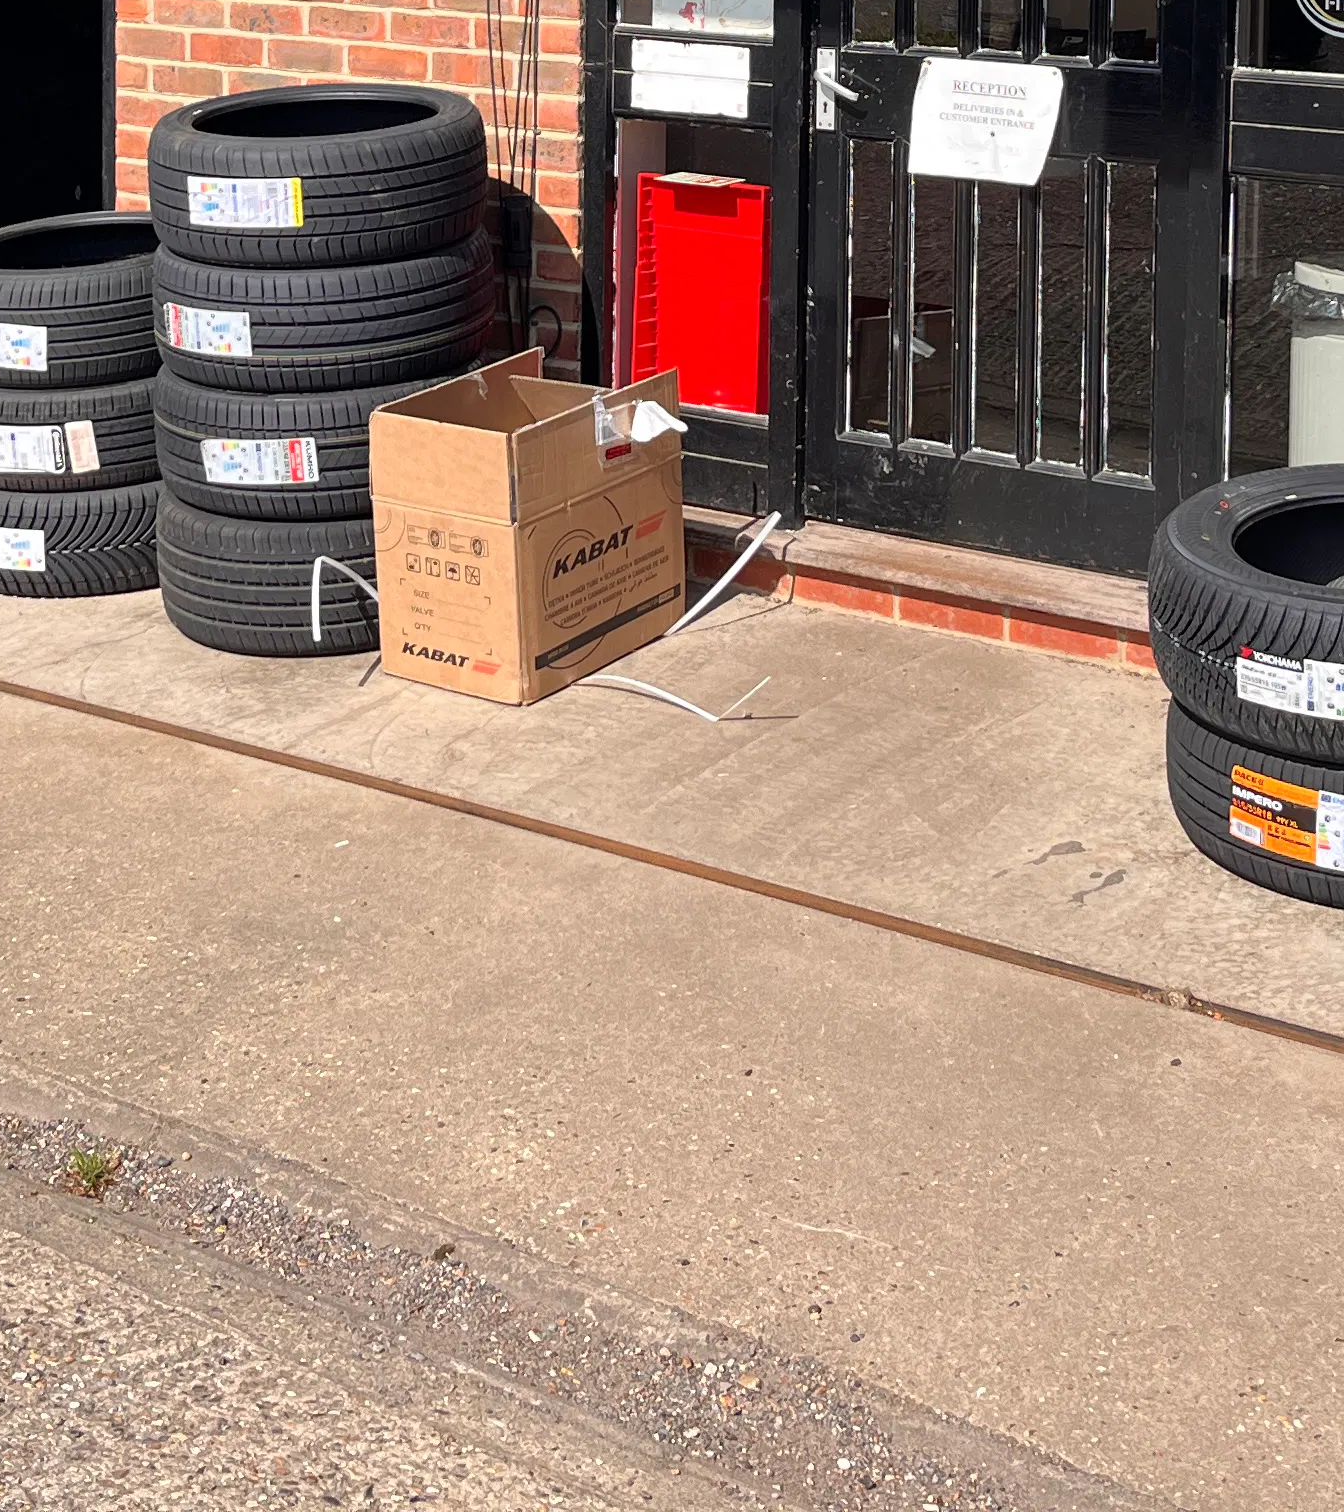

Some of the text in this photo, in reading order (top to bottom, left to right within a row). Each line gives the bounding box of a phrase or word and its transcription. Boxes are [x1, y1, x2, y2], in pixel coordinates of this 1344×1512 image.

[952, 80, 1027, 97] RECEPTION
[953, 103, 1025, 117] DELIVERIES IN &
[939, 112, 1035, 130] CUSTOMER ENTRANCE
[552, 524, 634, 580] KABAT
[413, 589, 430, 600] SIZE
[410, 605, 434, 617] VALVE
[414, 622, 431, 633] QTY
[401, 642, 470, 668] KABAT
[1253, 650, 1303, 671] YOKOHAMA
[1232, 785, 1283, 811] IMPERO
